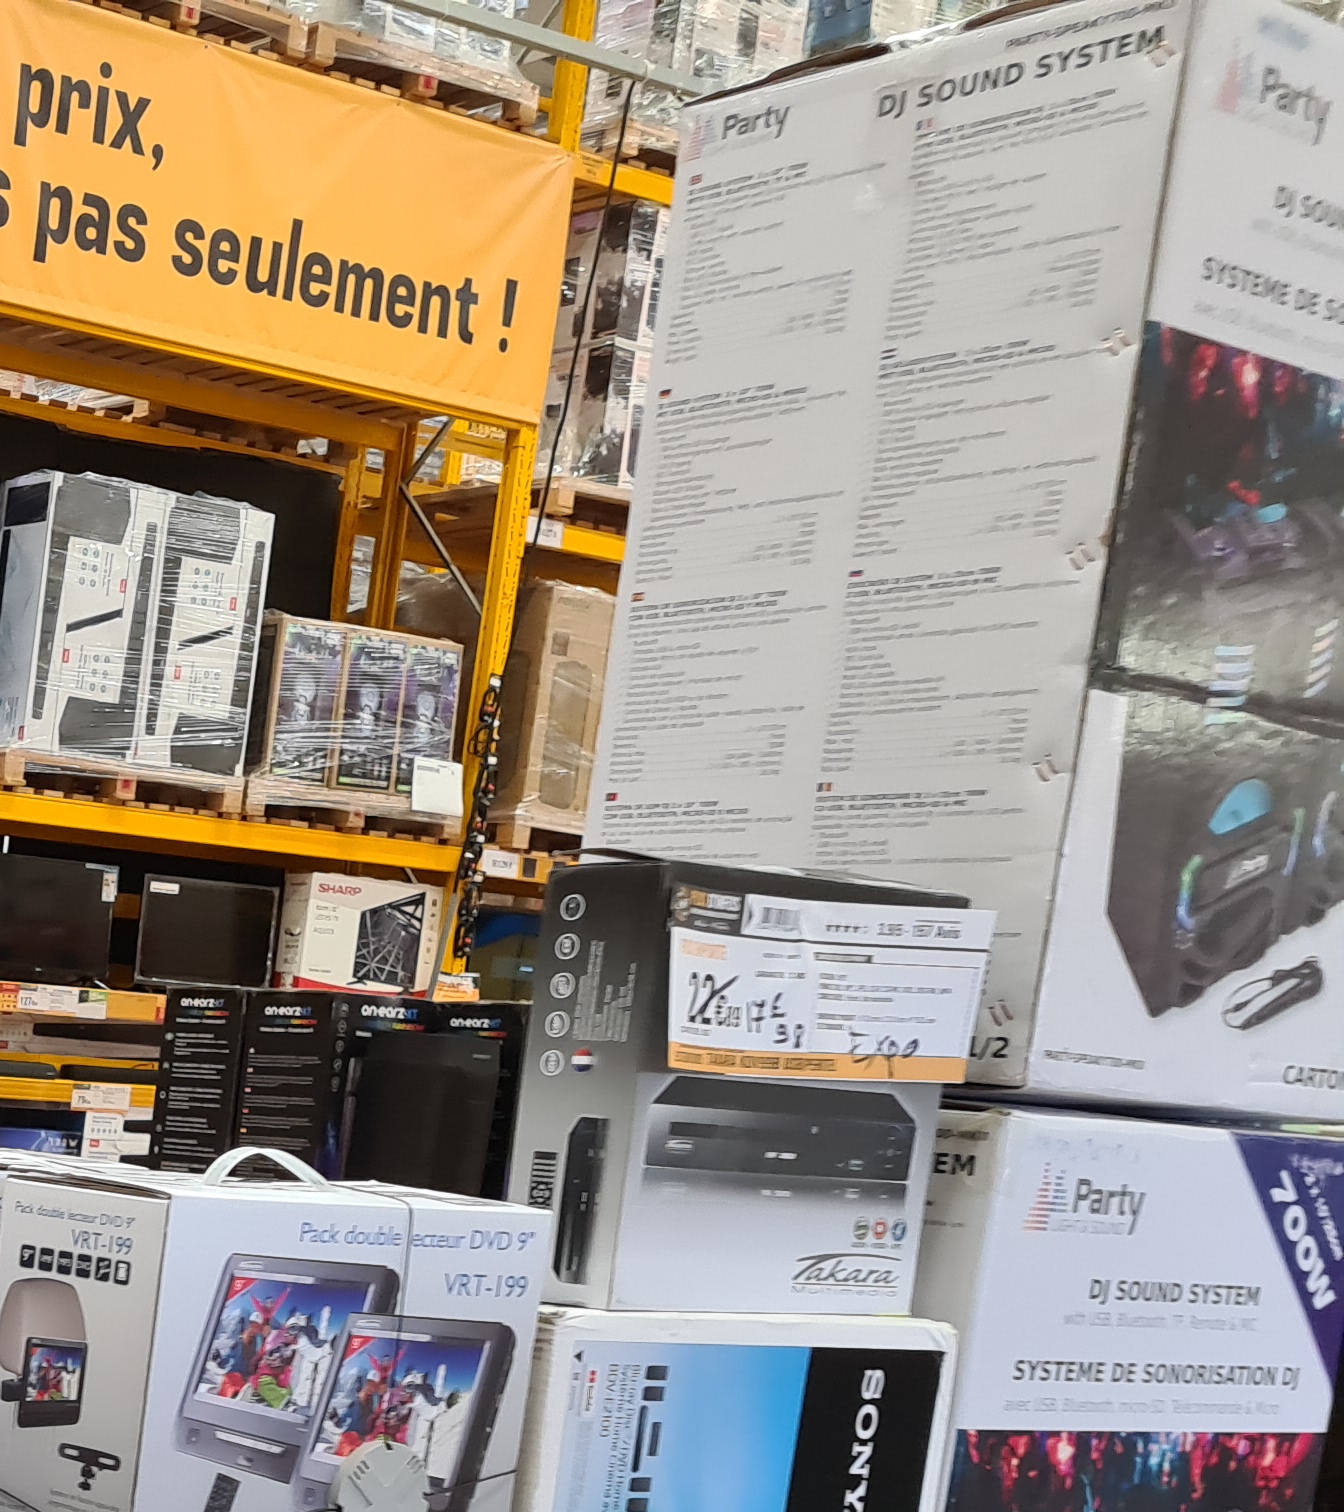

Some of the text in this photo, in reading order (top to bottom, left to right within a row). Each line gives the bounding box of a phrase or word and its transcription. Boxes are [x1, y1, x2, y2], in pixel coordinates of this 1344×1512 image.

[876, 25, 1167, 119] DJ SOUND SYSTEM
[14, 62, 166, 172] prix,
[720, 106, 791, 139] Party
[33, 179, 148, 264] pas
[170, 216, 479, 345] seulement
[498, 278, 519, 353] !
[317, 883, 363, 896] SHARP
[36, 1204, 66, 1220] double
[1073, 1179, 1145, 1235] Party
[70, 1230, 133, 1256] VRT-199
[299, 1222, 513, 1250] Pack double DVD
[1270, 1171, 1336, 1310] 700W
[445, 1272, 529, 1299] VRT-199
[792, 1253, 902, 1286] Takara
[1089, 1279, 1261, 1307] DJ SOUND SYSTEM
[1012, 1359, 1301, 1391] SYSTEME DE SONORISATION DJ
